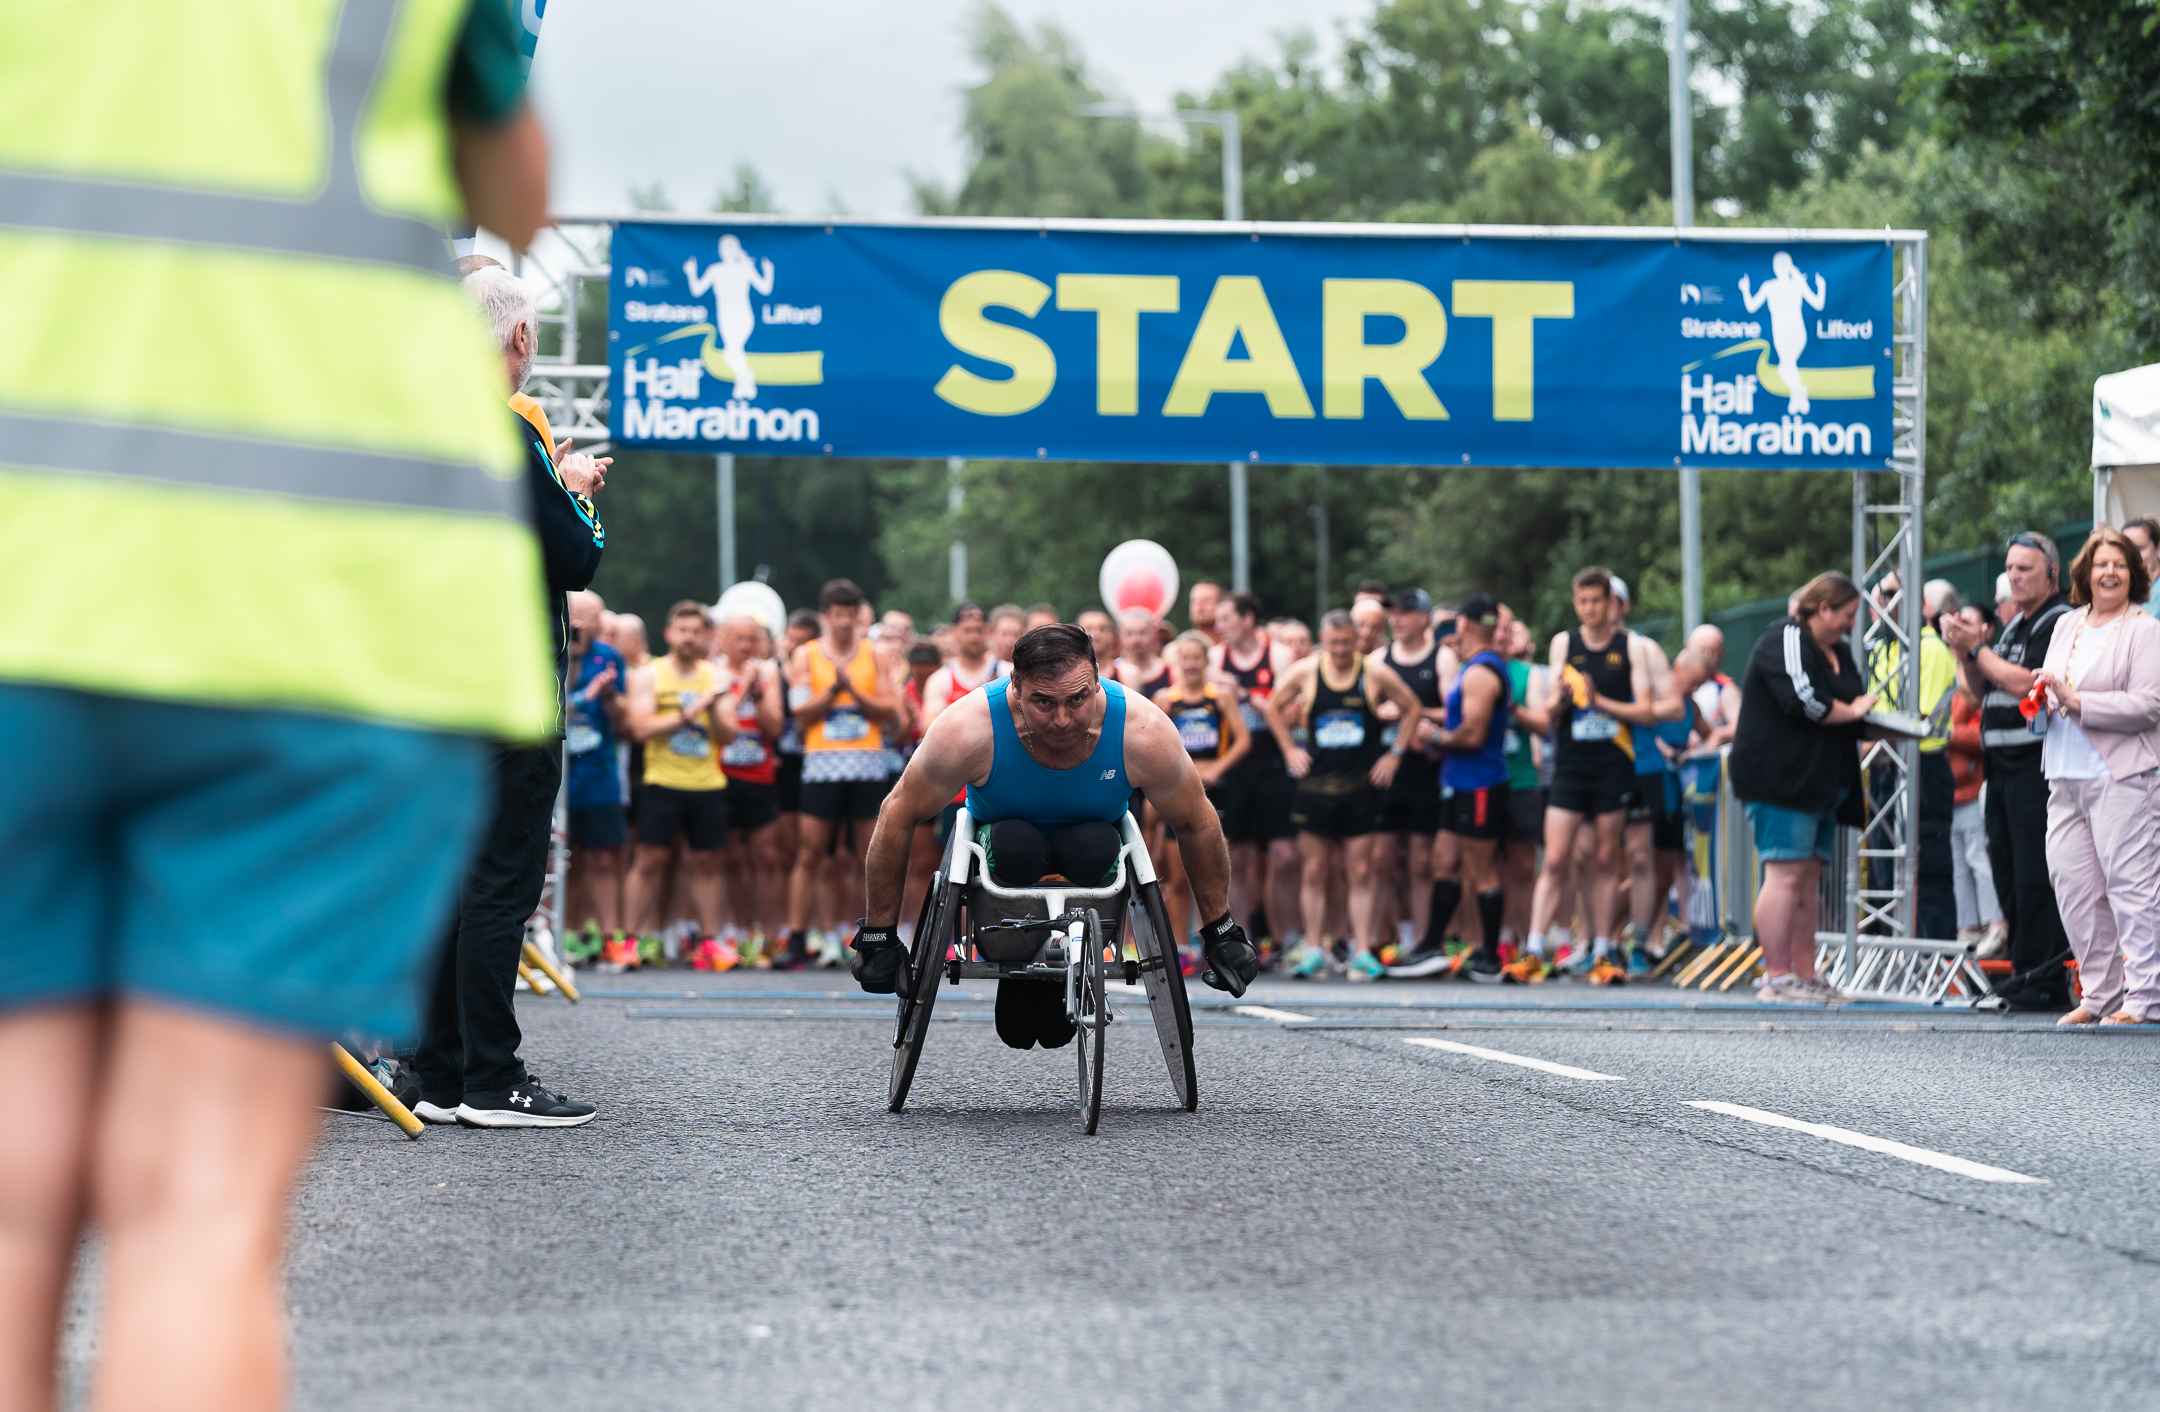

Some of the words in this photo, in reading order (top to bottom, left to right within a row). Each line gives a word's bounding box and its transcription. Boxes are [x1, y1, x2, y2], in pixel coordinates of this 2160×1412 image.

[624, 300, 708, 323] Strabane
[762, 303, 823, 325] Lifford
[1681, 317, 1761, 338] Strabane
[1816, 319, 1873, 339] Lifford
[934, 269, 1574, 421] START
[623, 358, 704, 399] Half
[1681, 374, 1757, 415] Half
[623, 397, 819, 441] Marathon
[1681, 414, 1871, 455] Marathon
[862, 932, 887, 942] HARNESS
